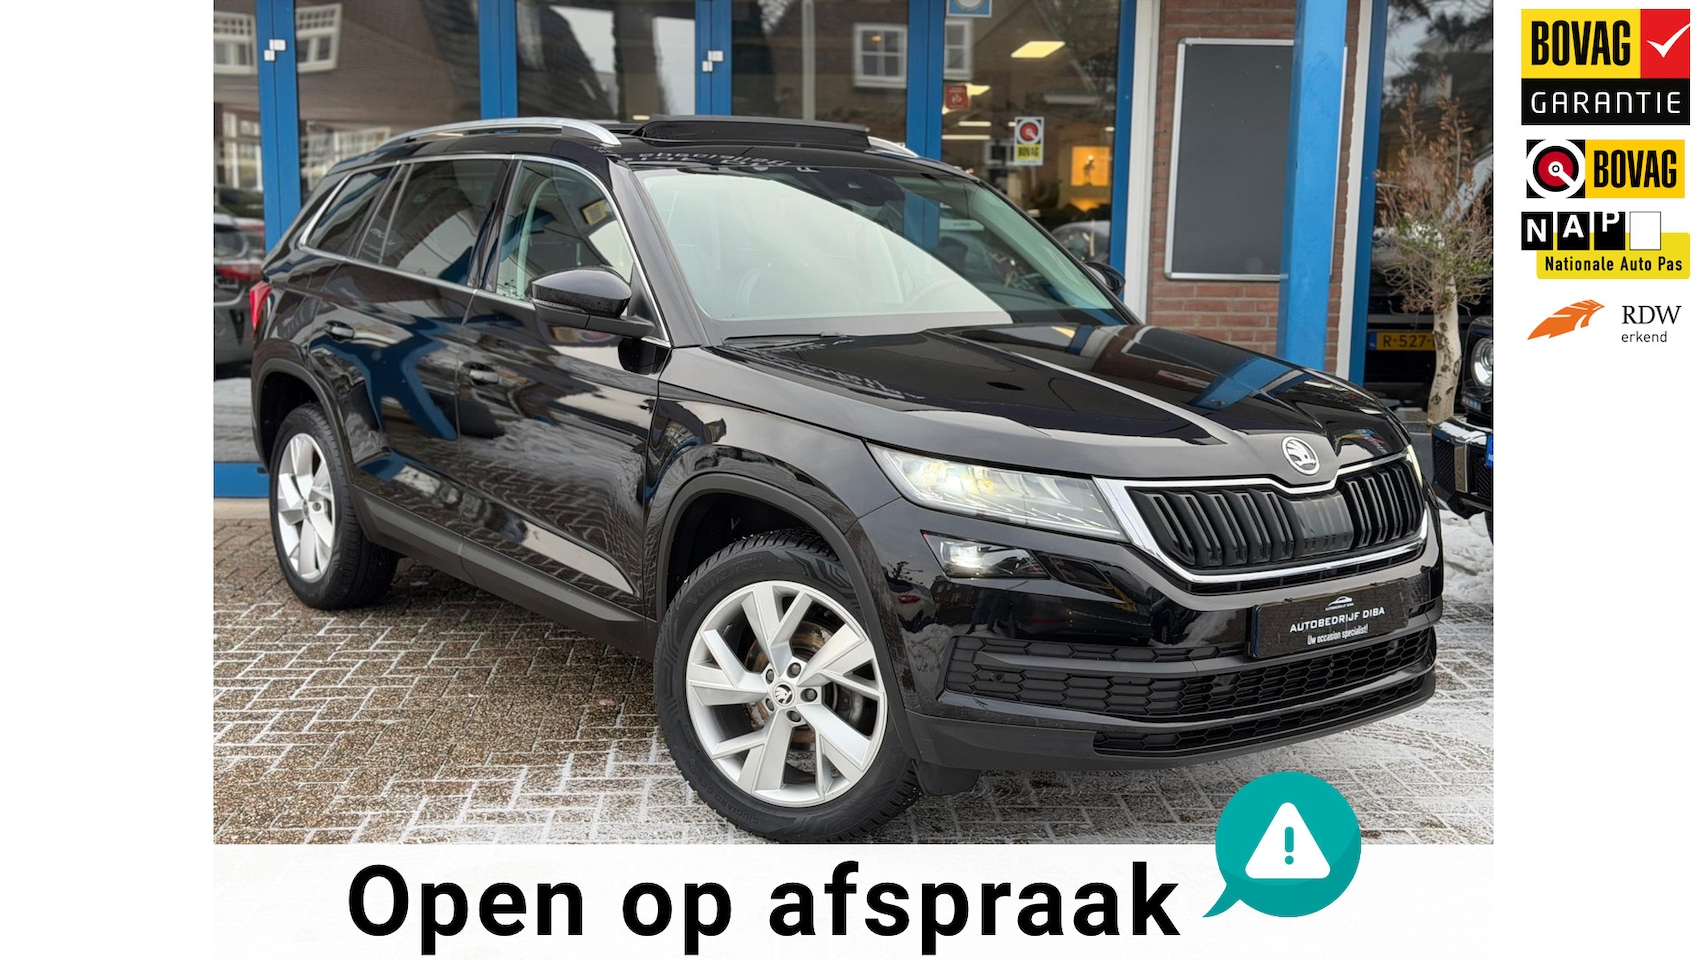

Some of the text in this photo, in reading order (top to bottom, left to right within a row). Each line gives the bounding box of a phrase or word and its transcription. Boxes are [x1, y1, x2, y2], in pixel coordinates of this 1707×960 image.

[1383, 335, 1436, 348] R-527-
[1290, 612, 1360, 632] AUTOBEDRIJF
[1362, 607, 1385, 618] DIBA
[1307, 634, 1317, 645] Uw
[1316, 631, 1342, 643] occasion
